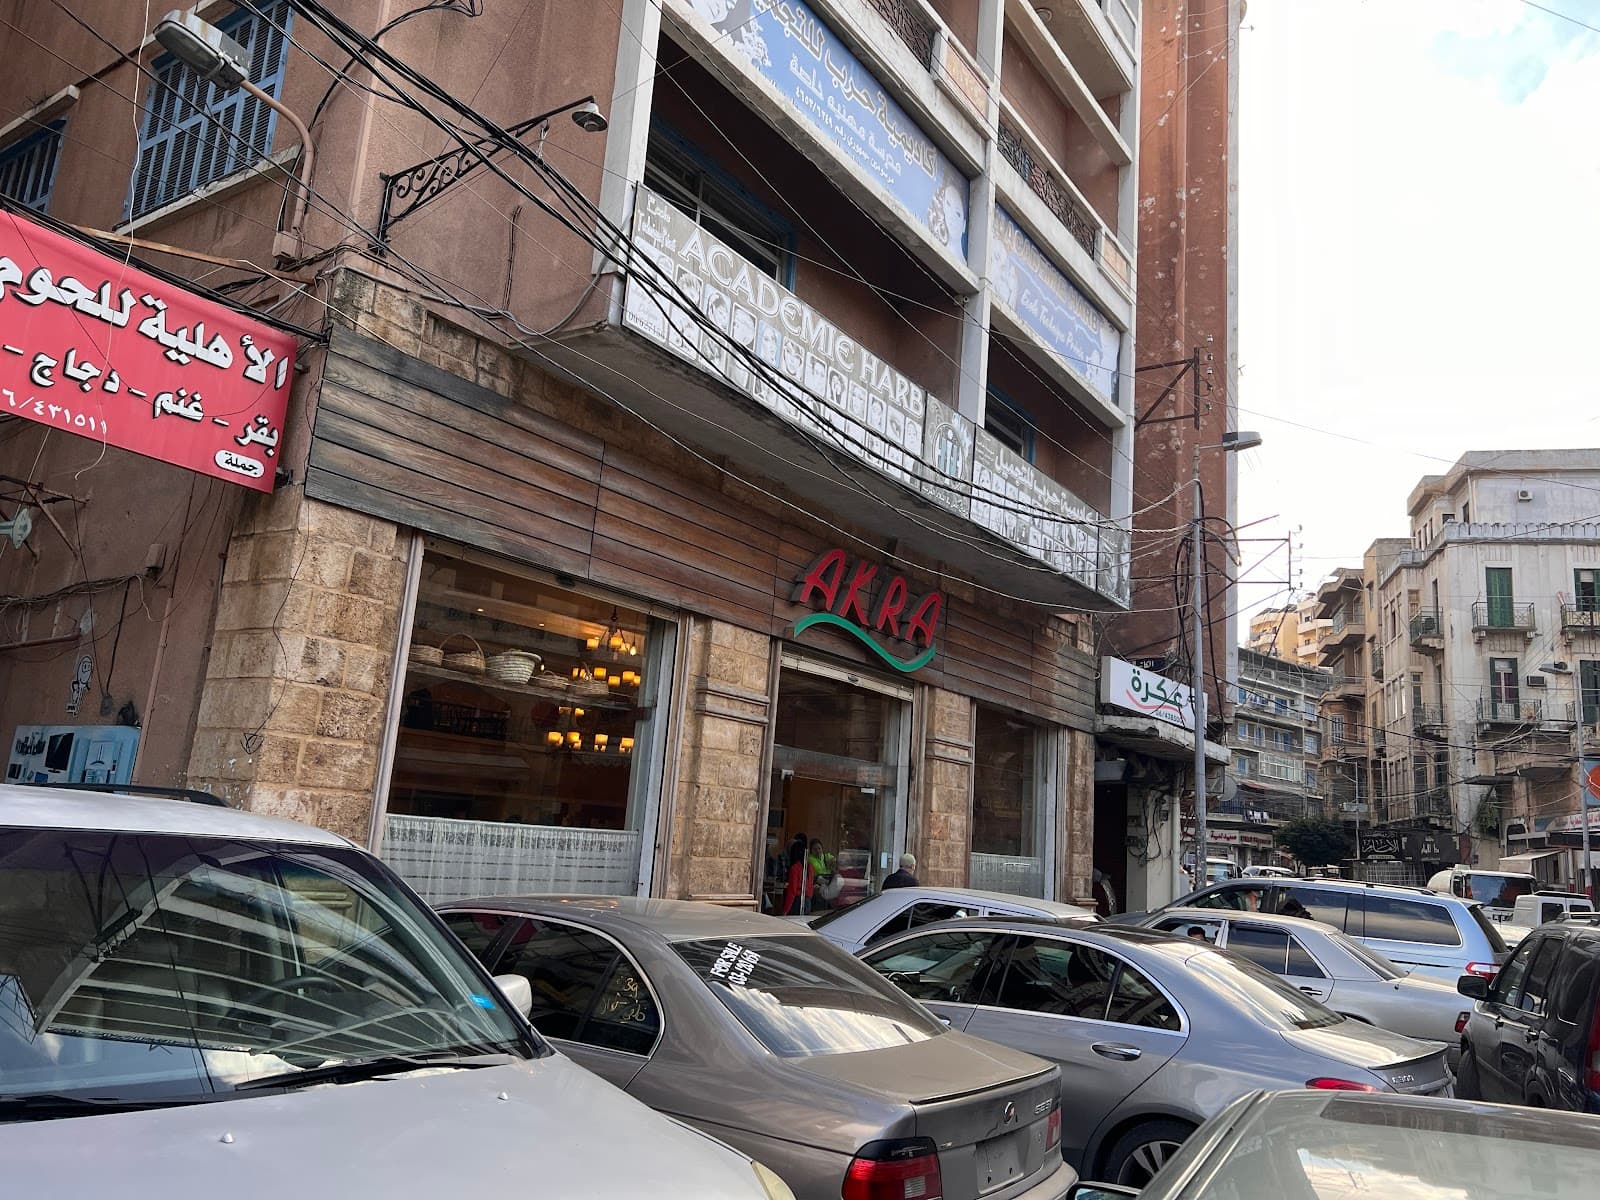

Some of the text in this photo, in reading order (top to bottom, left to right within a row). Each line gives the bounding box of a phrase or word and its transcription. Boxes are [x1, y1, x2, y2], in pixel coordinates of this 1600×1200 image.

[825, 48, 876, 115] حرب
[138, 293, 289, 389] الأهلية
[31, 348, 120, 393] دجاج
[859, 347, 924, 419] HARB
[153, 387, 204, 424] غنم
[235, 415, 279, 456] بقر
[223, 452, 258, 474] جملة
[795, 547, 943, 649] AKRA
[1131, 668, 1184, 707] عكرة
[710, 942, 743, 978] FOR SALE
